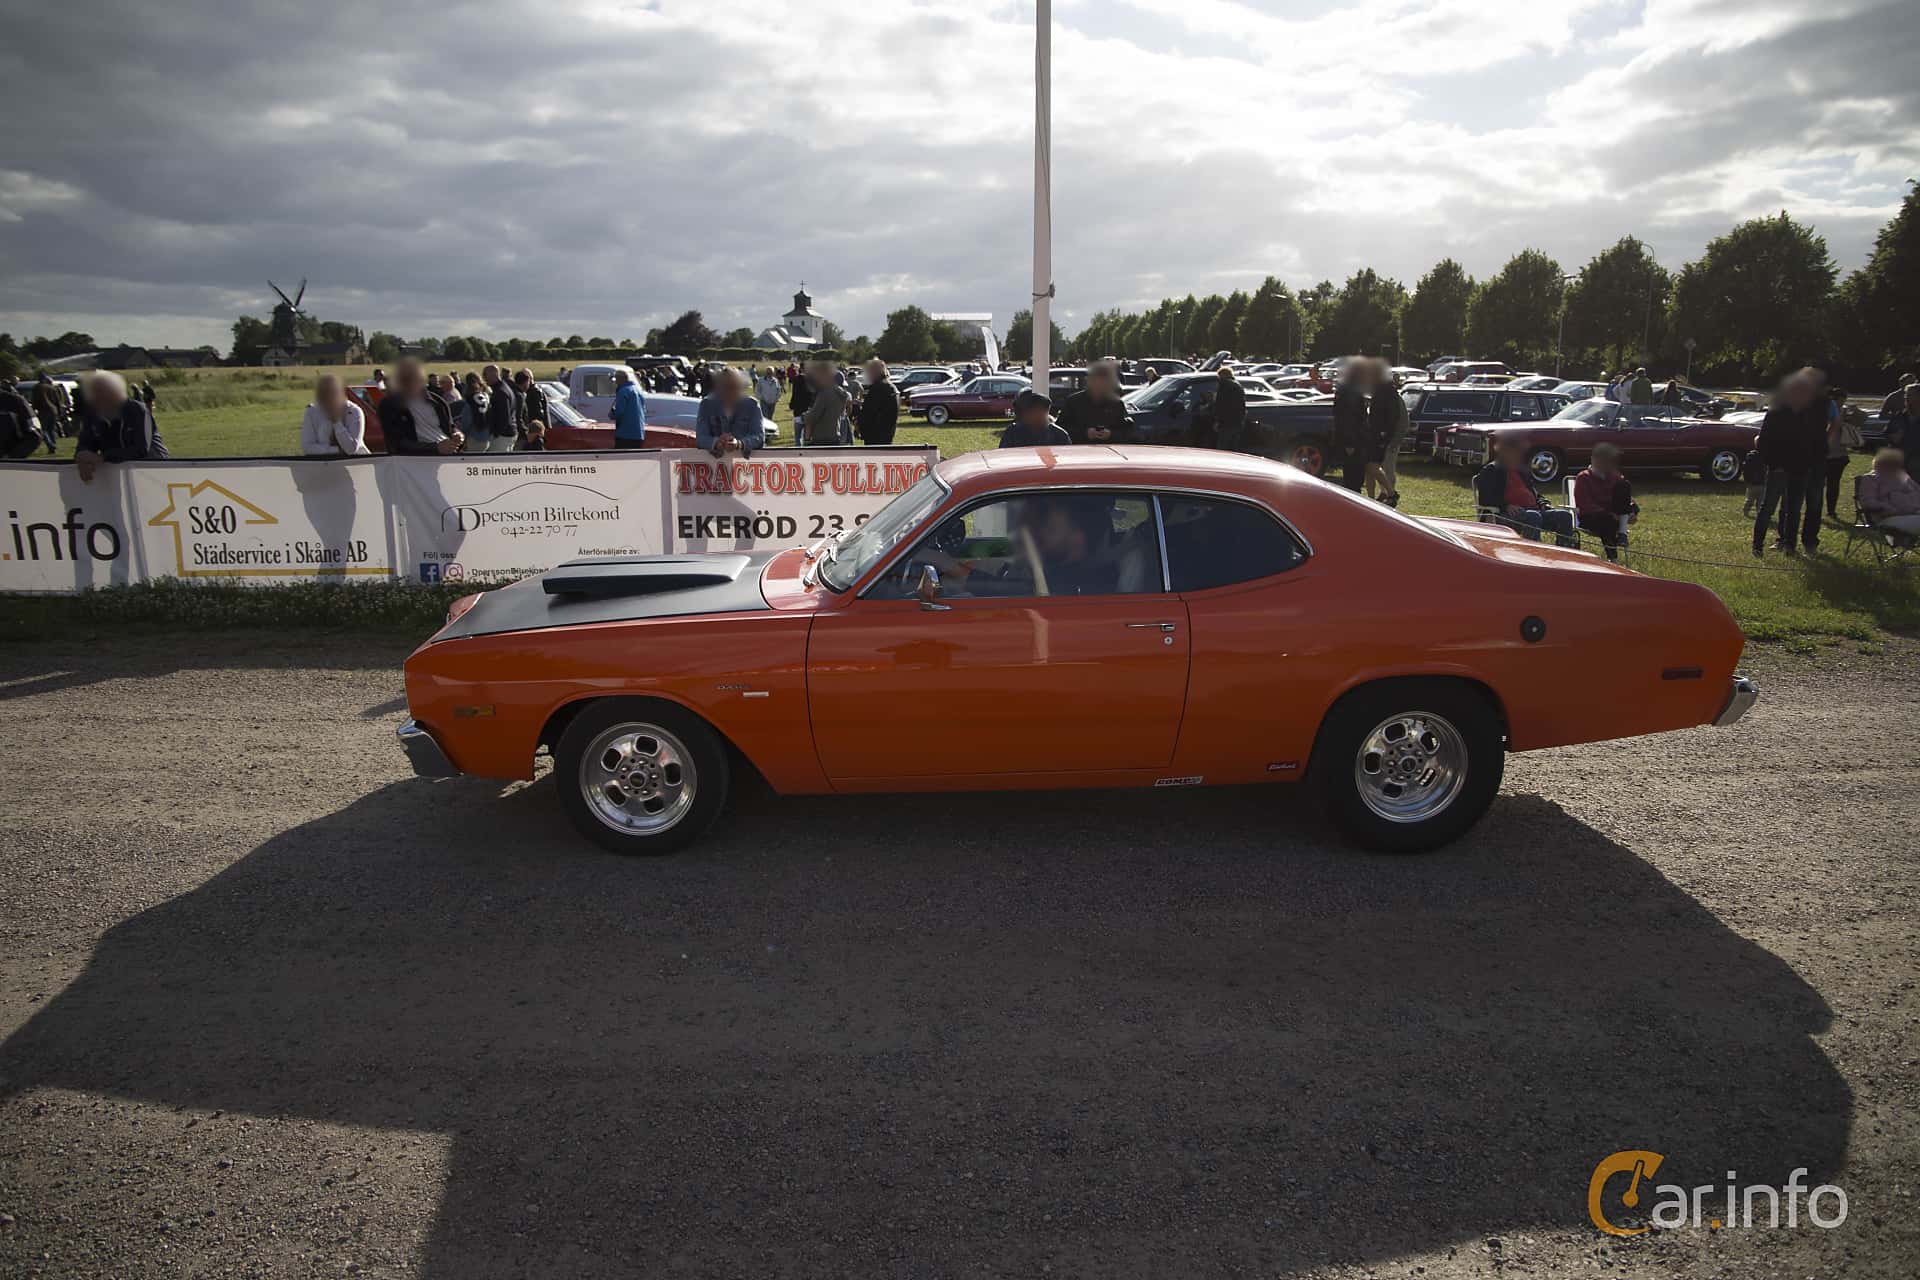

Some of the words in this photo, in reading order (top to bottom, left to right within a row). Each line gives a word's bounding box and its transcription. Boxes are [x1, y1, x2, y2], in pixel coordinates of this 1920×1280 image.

[466, 466, 479, 476] 38
[481, 466, 521, 476] minuter
[524, 464, 567, 475] härifrån
[569, 465, 597, 474] finns
[674, 461, 804, 494] TRACTOR
[188, 505, 237, 534] S&O
[544, 505, 621, 521] Bilrekond
[677, 510, 797, 539] EKERÖD
[501, 525, 543, 537] 042-22
[545, 525, 561, 537] 70
[563, 524, 579, 537] 77
[193, 542, 281, 565] Städservice
[285, 543, 291, 564] i
[295, 541, 341, 564] Skåne
[345, 540, 368, 563] AB
